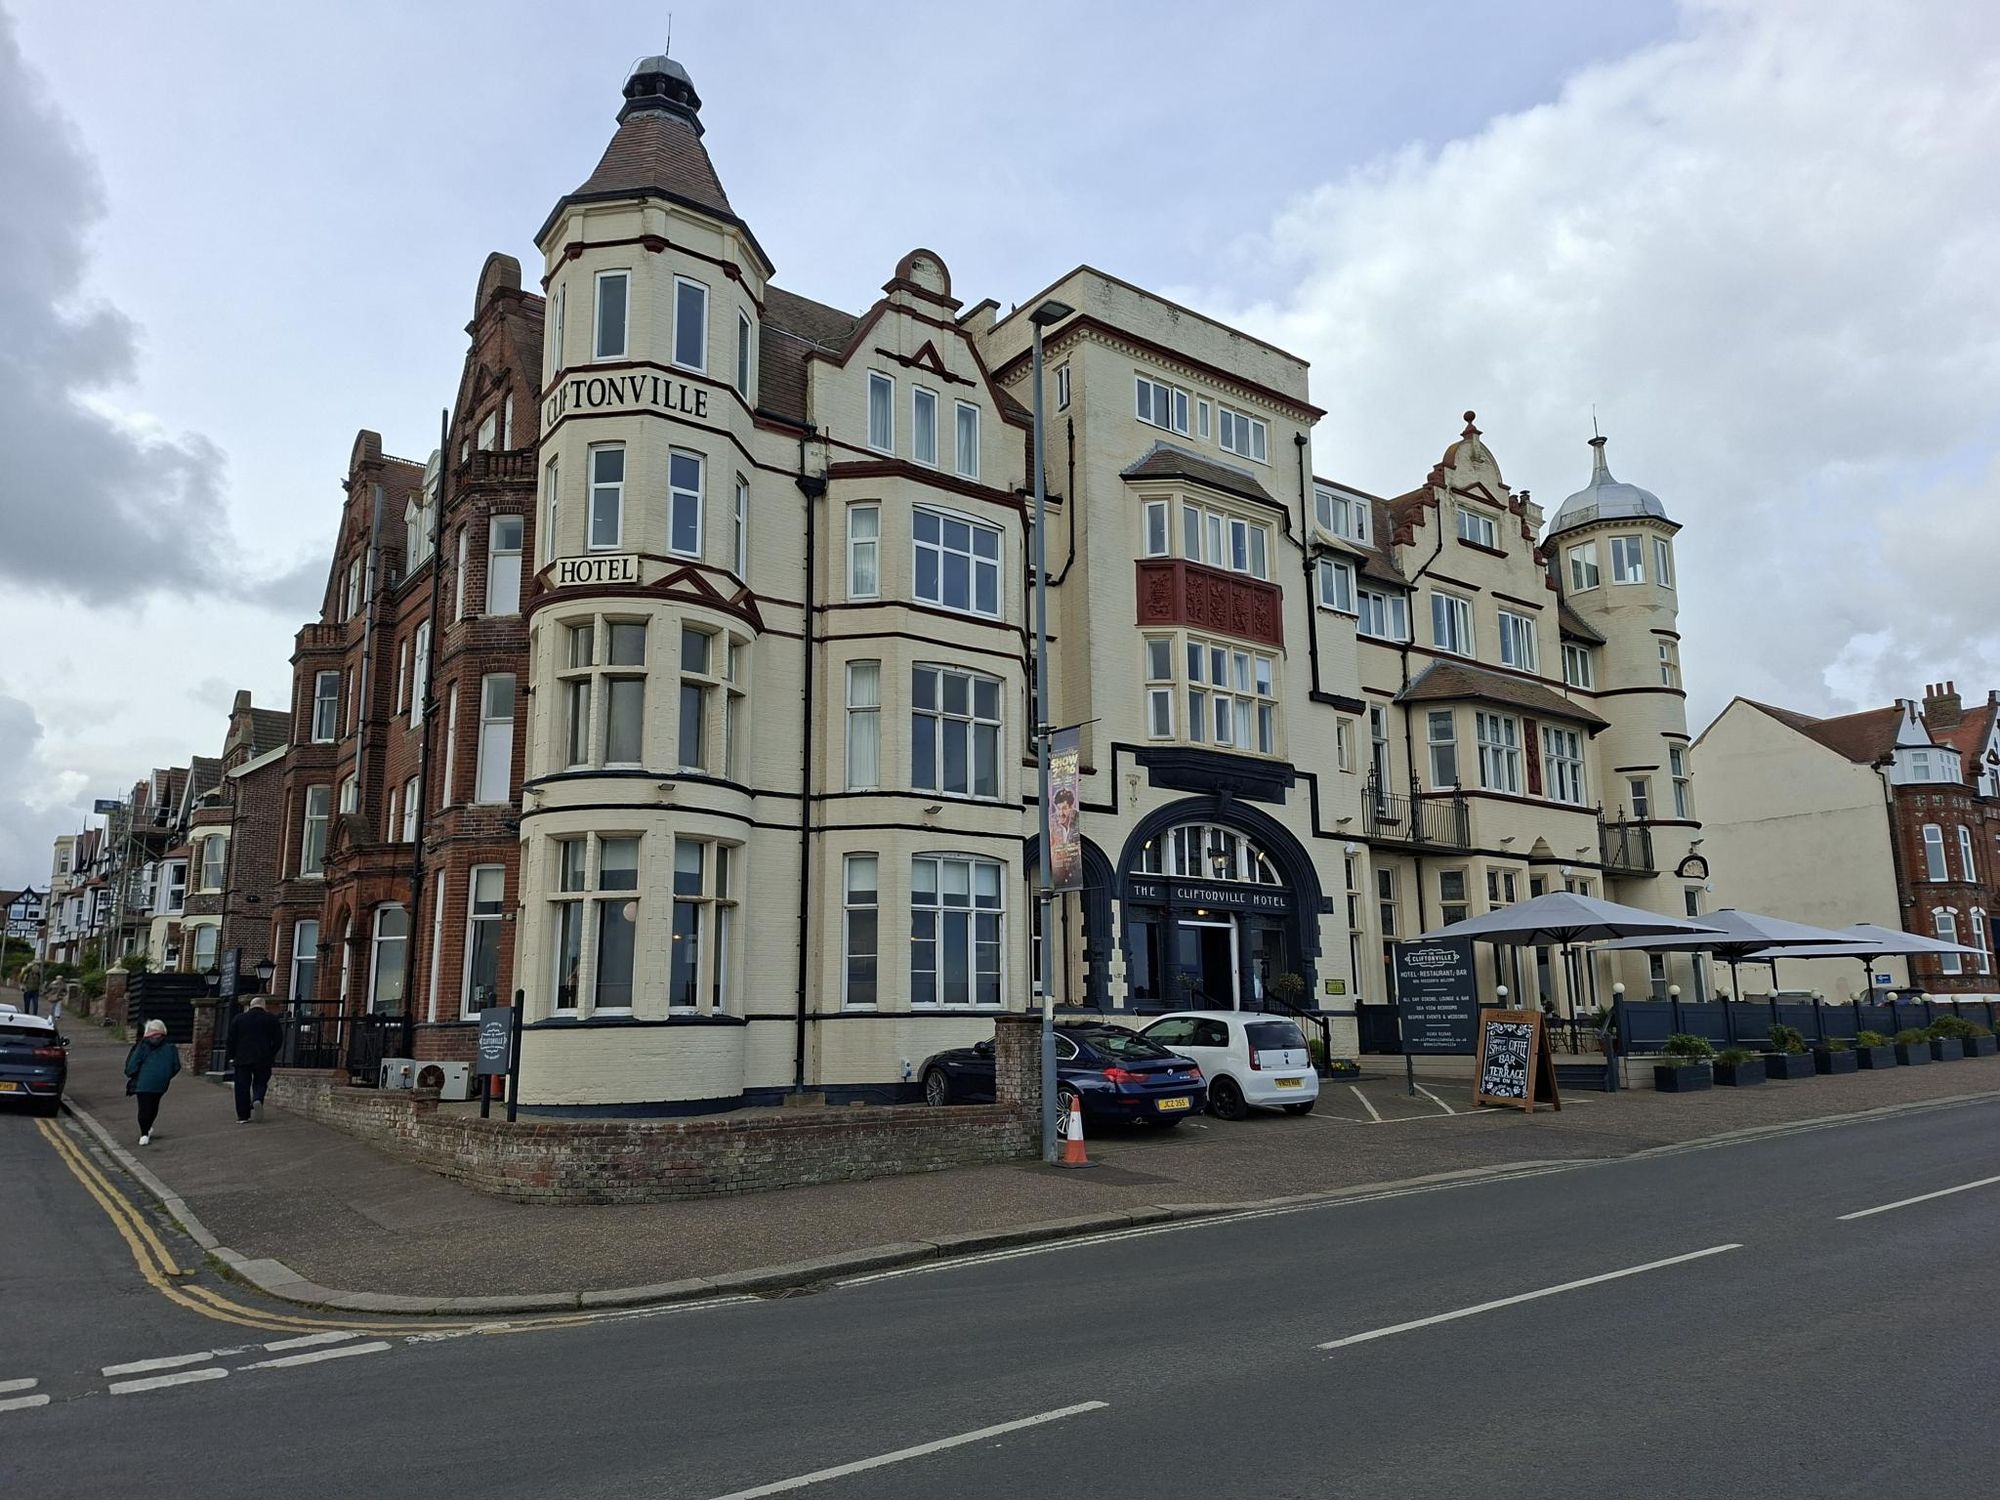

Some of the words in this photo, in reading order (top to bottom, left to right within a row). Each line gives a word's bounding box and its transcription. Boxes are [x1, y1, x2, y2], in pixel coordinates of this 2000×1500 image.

[547, 374, 708, 427] CLIFTONVILLE
[560, 558, 634, 583] HOTEL
[1051, 754, 1078, 769] SHOW
[1134, 885, 1156, 897] THE
[1177, 887, 1246, 903] CLIFTONVILLE
[1253, 894, 1287, 907] HOTEL
[1508, 1039, 1528, 1058] COFFEE
[1498, 1054, 1516, 1065] BAR
[1489, 1066, 1525, 1079] TERRACE
